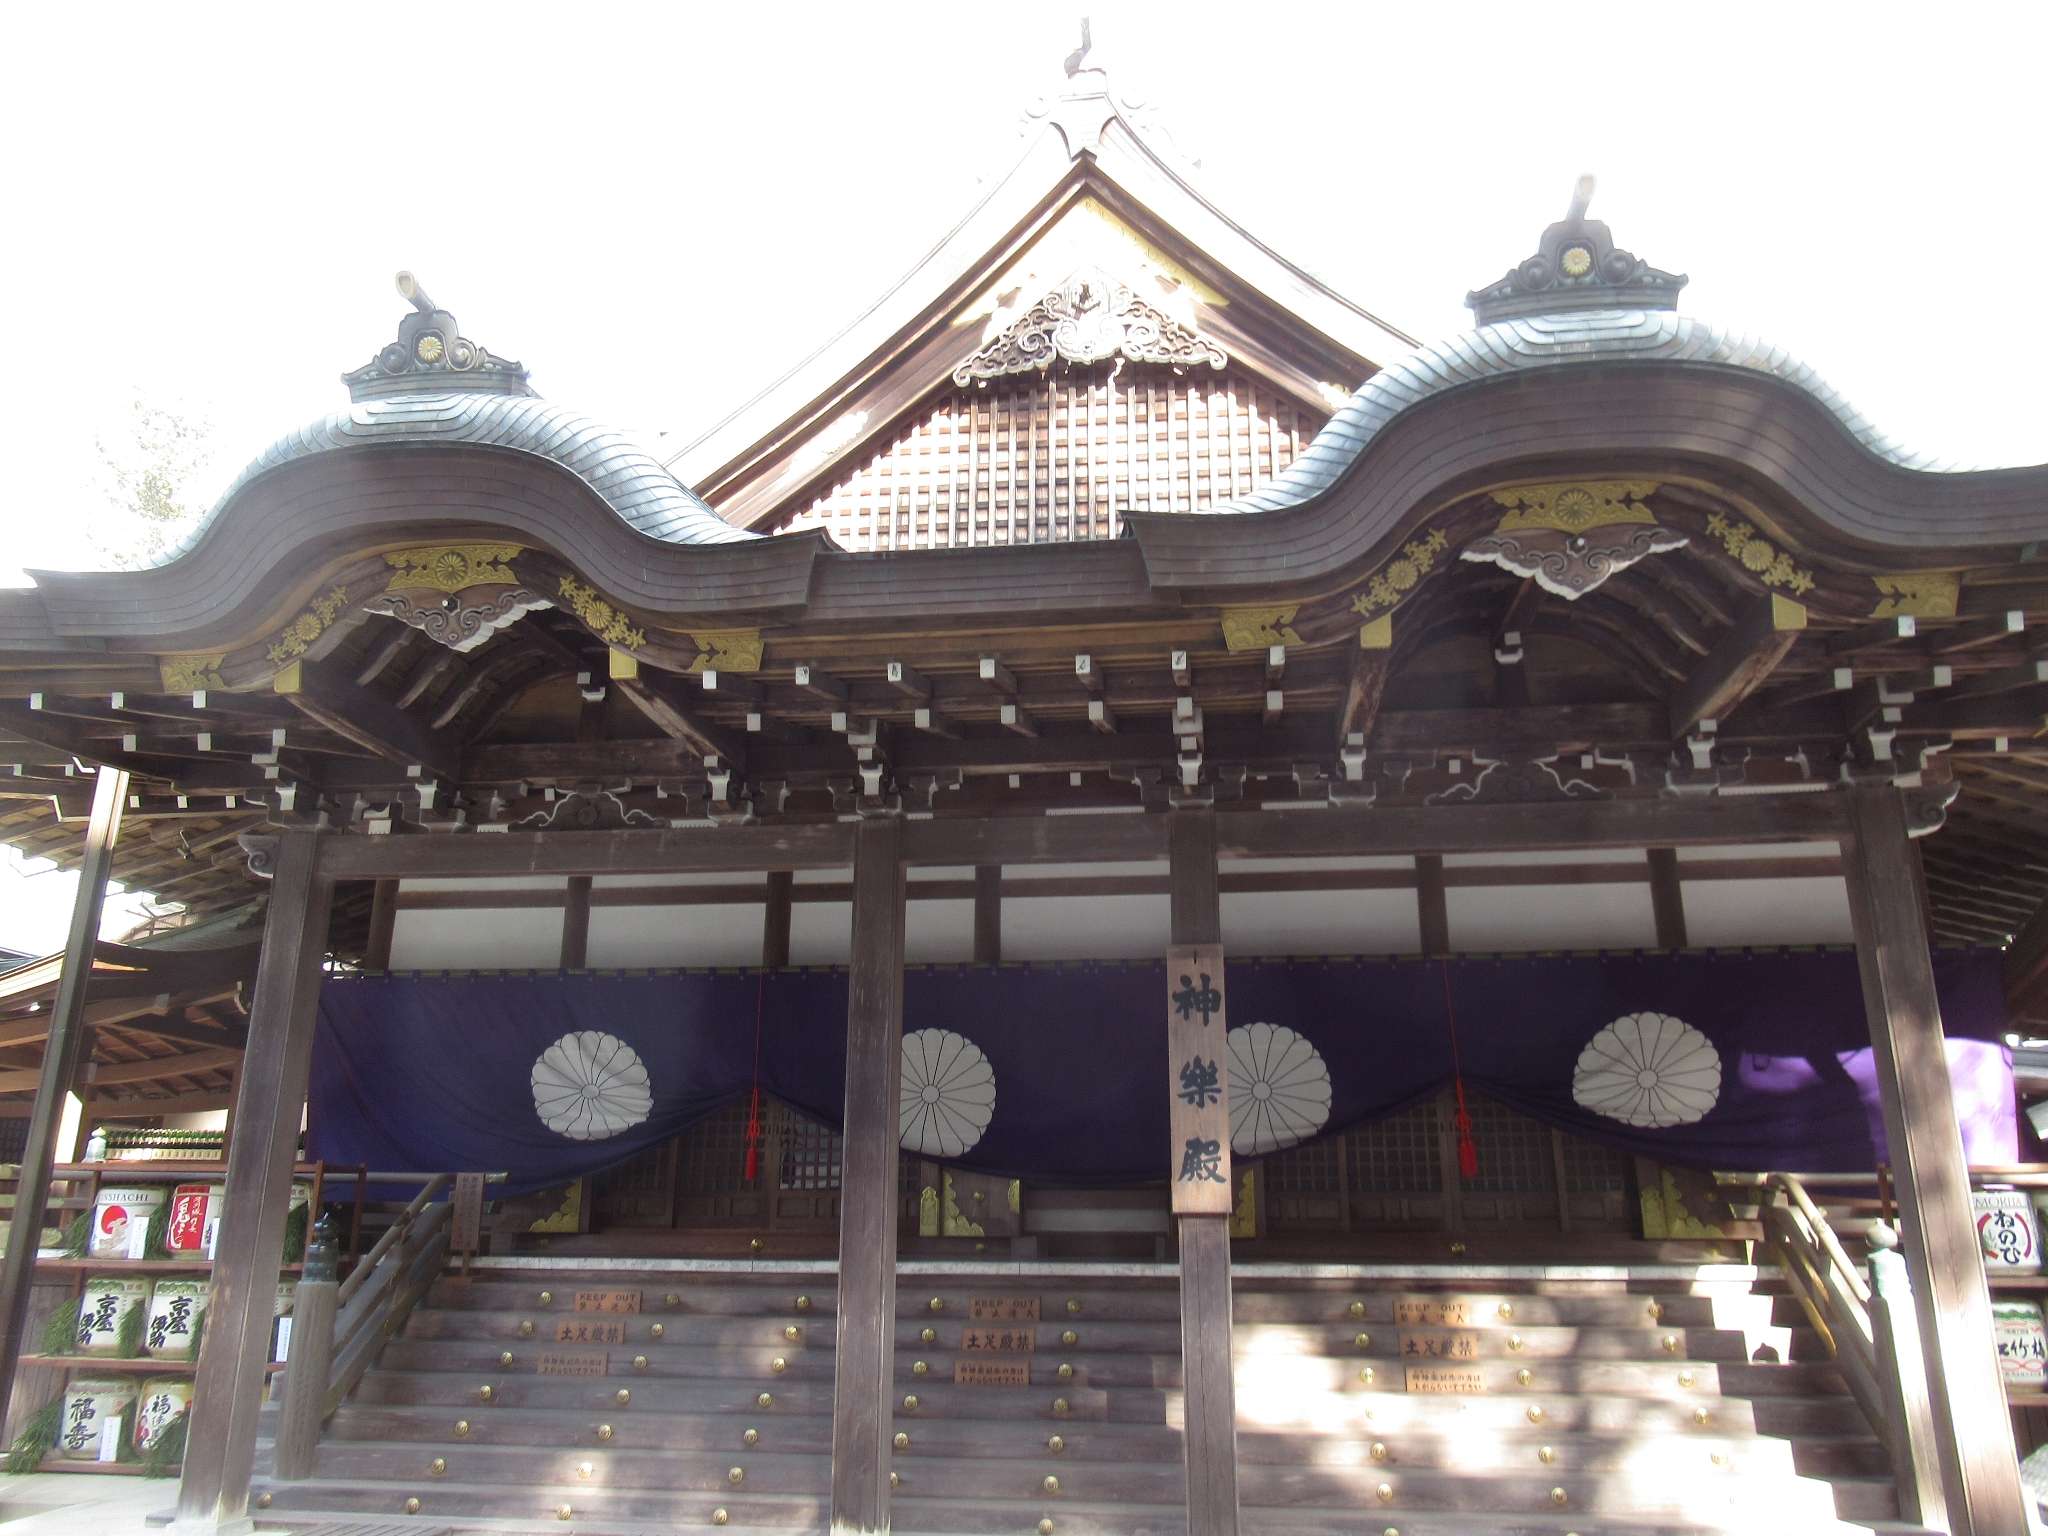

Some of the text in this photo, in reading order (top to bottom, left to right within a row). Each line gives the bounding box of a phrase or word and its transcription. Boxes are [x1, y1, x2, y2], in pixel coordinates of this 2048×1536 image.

[1172, 973, 1227, 1184] 神樂殿
[1994, 1210, 2022, 1264] ねのひ
[579, 1294, 637, 1302] KEEP OUT
[975, 1300, 1034, 1308] KEEP OUT
[1399, 1303, 1463, 1312] KEEP OUT
